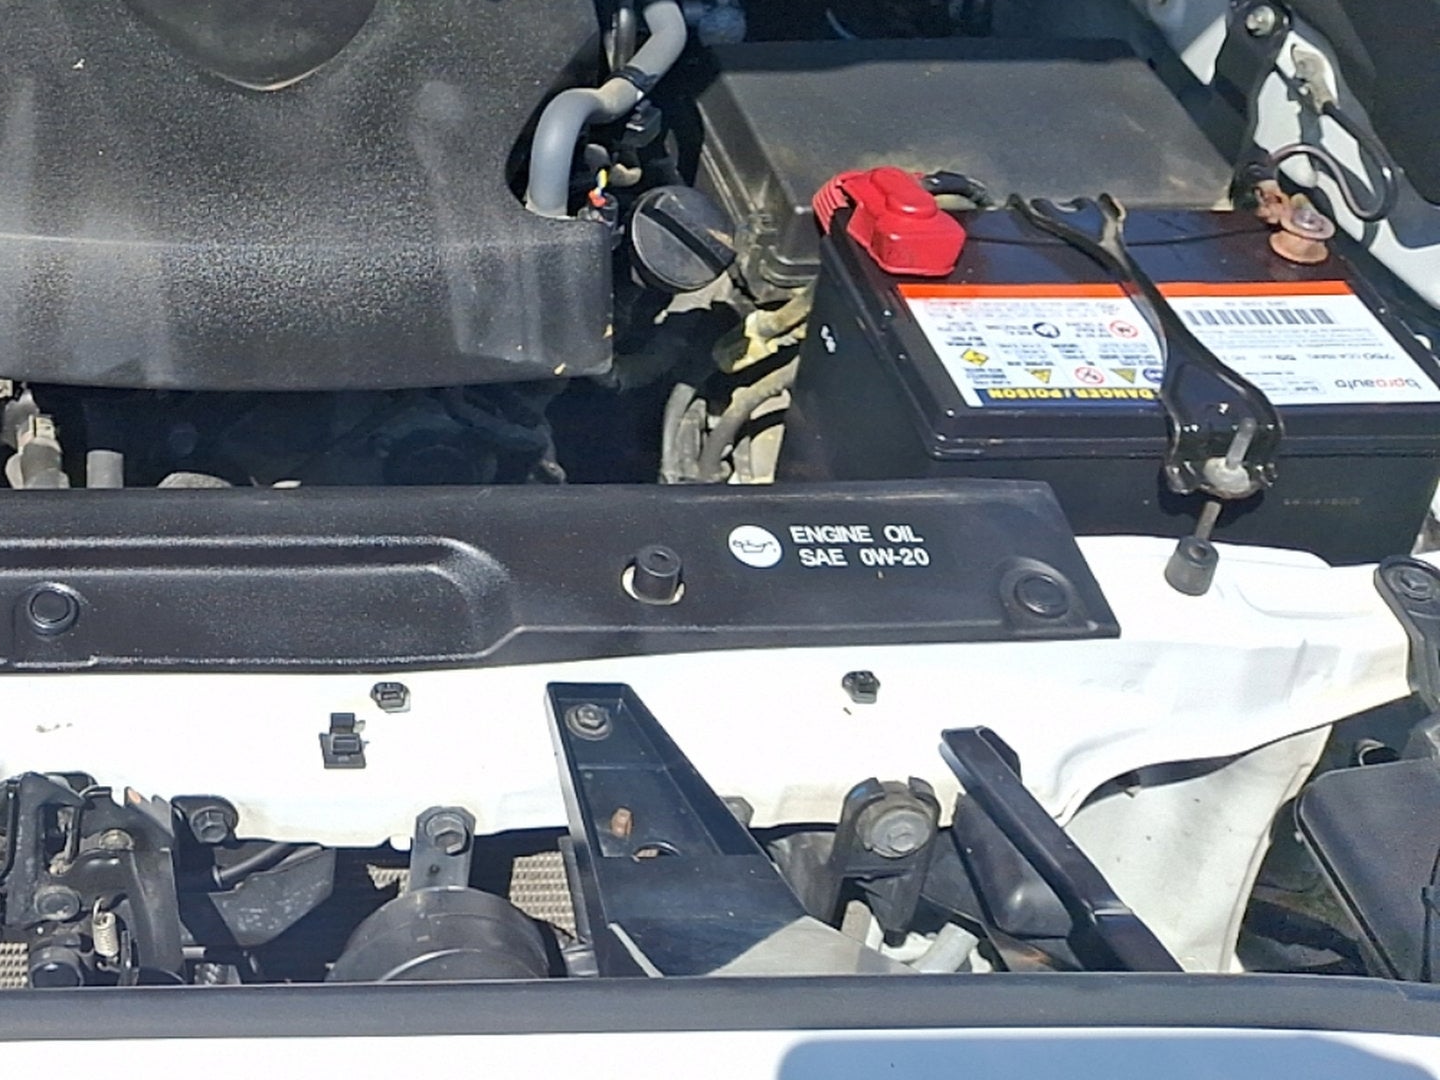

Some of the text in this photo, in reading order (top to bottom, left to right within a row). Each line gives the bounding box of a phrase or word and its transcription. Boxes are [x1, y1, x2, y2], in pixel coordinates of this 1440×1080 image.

[1335, 378, 1421, 390] bproauto
[987, 388, 1063, 399] POISON
[1074, 388, 1155, 399] DANGER
[789, 524, 924, 543] ENGINE OIL
[798, 547, 930, 566] SAE 0W-20
